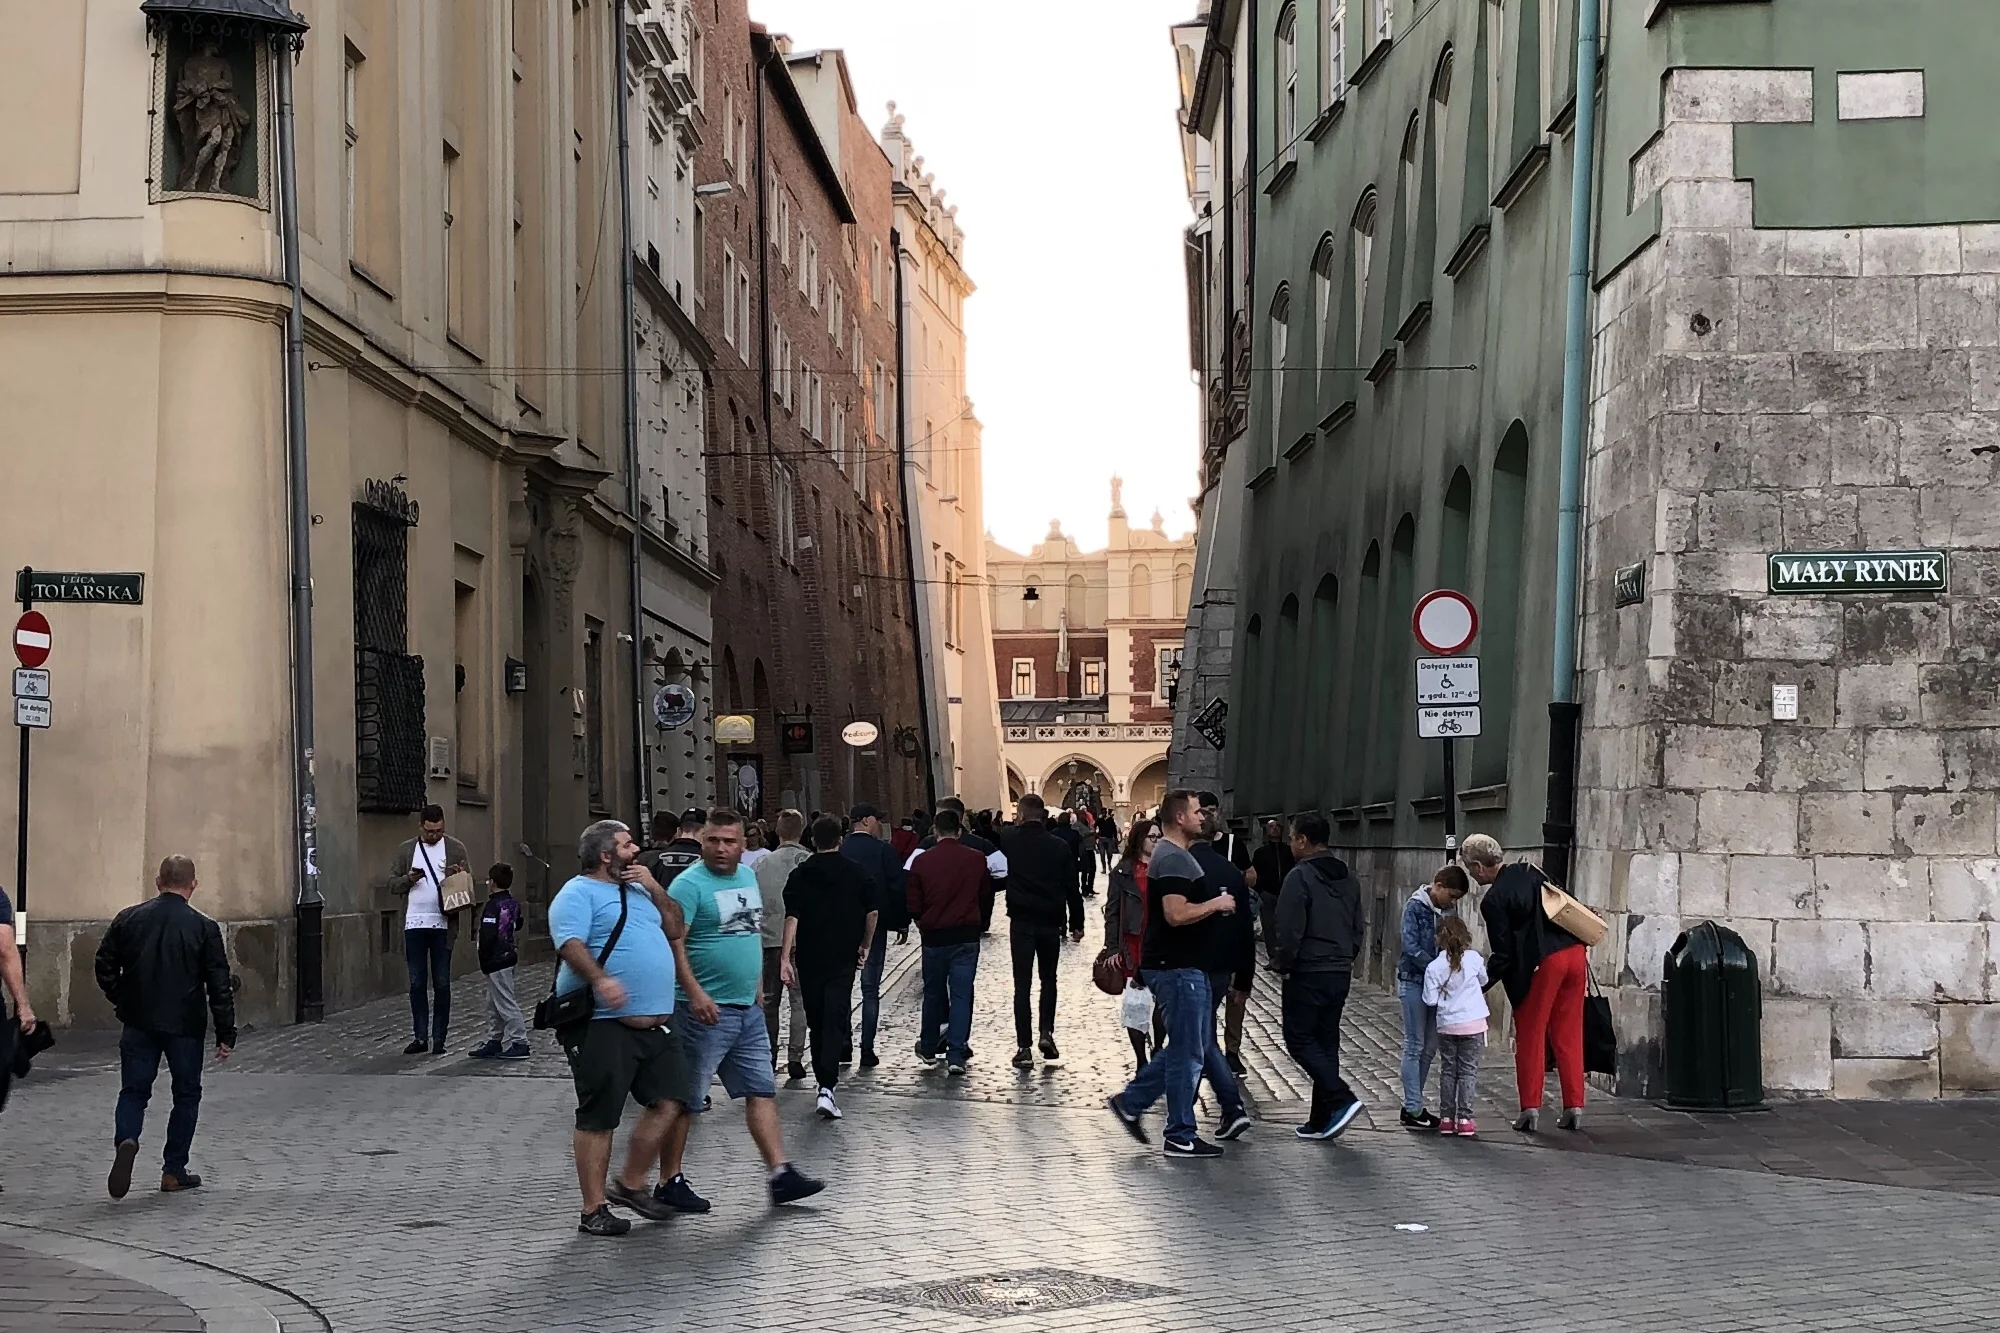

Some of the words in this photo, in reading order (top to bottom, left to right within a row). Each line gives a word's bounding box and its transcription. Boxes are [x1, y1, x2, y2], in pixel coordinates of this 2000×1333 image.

[1776, 560, 1849, 584] MAŁY
[1854, 559, 1940, 582] RYNEK
[30, 583, 133, 600] TOLARSKA
[1424, 710, 1439, 718] Nie
[1442, 710, 1473, 718] dotyczy
